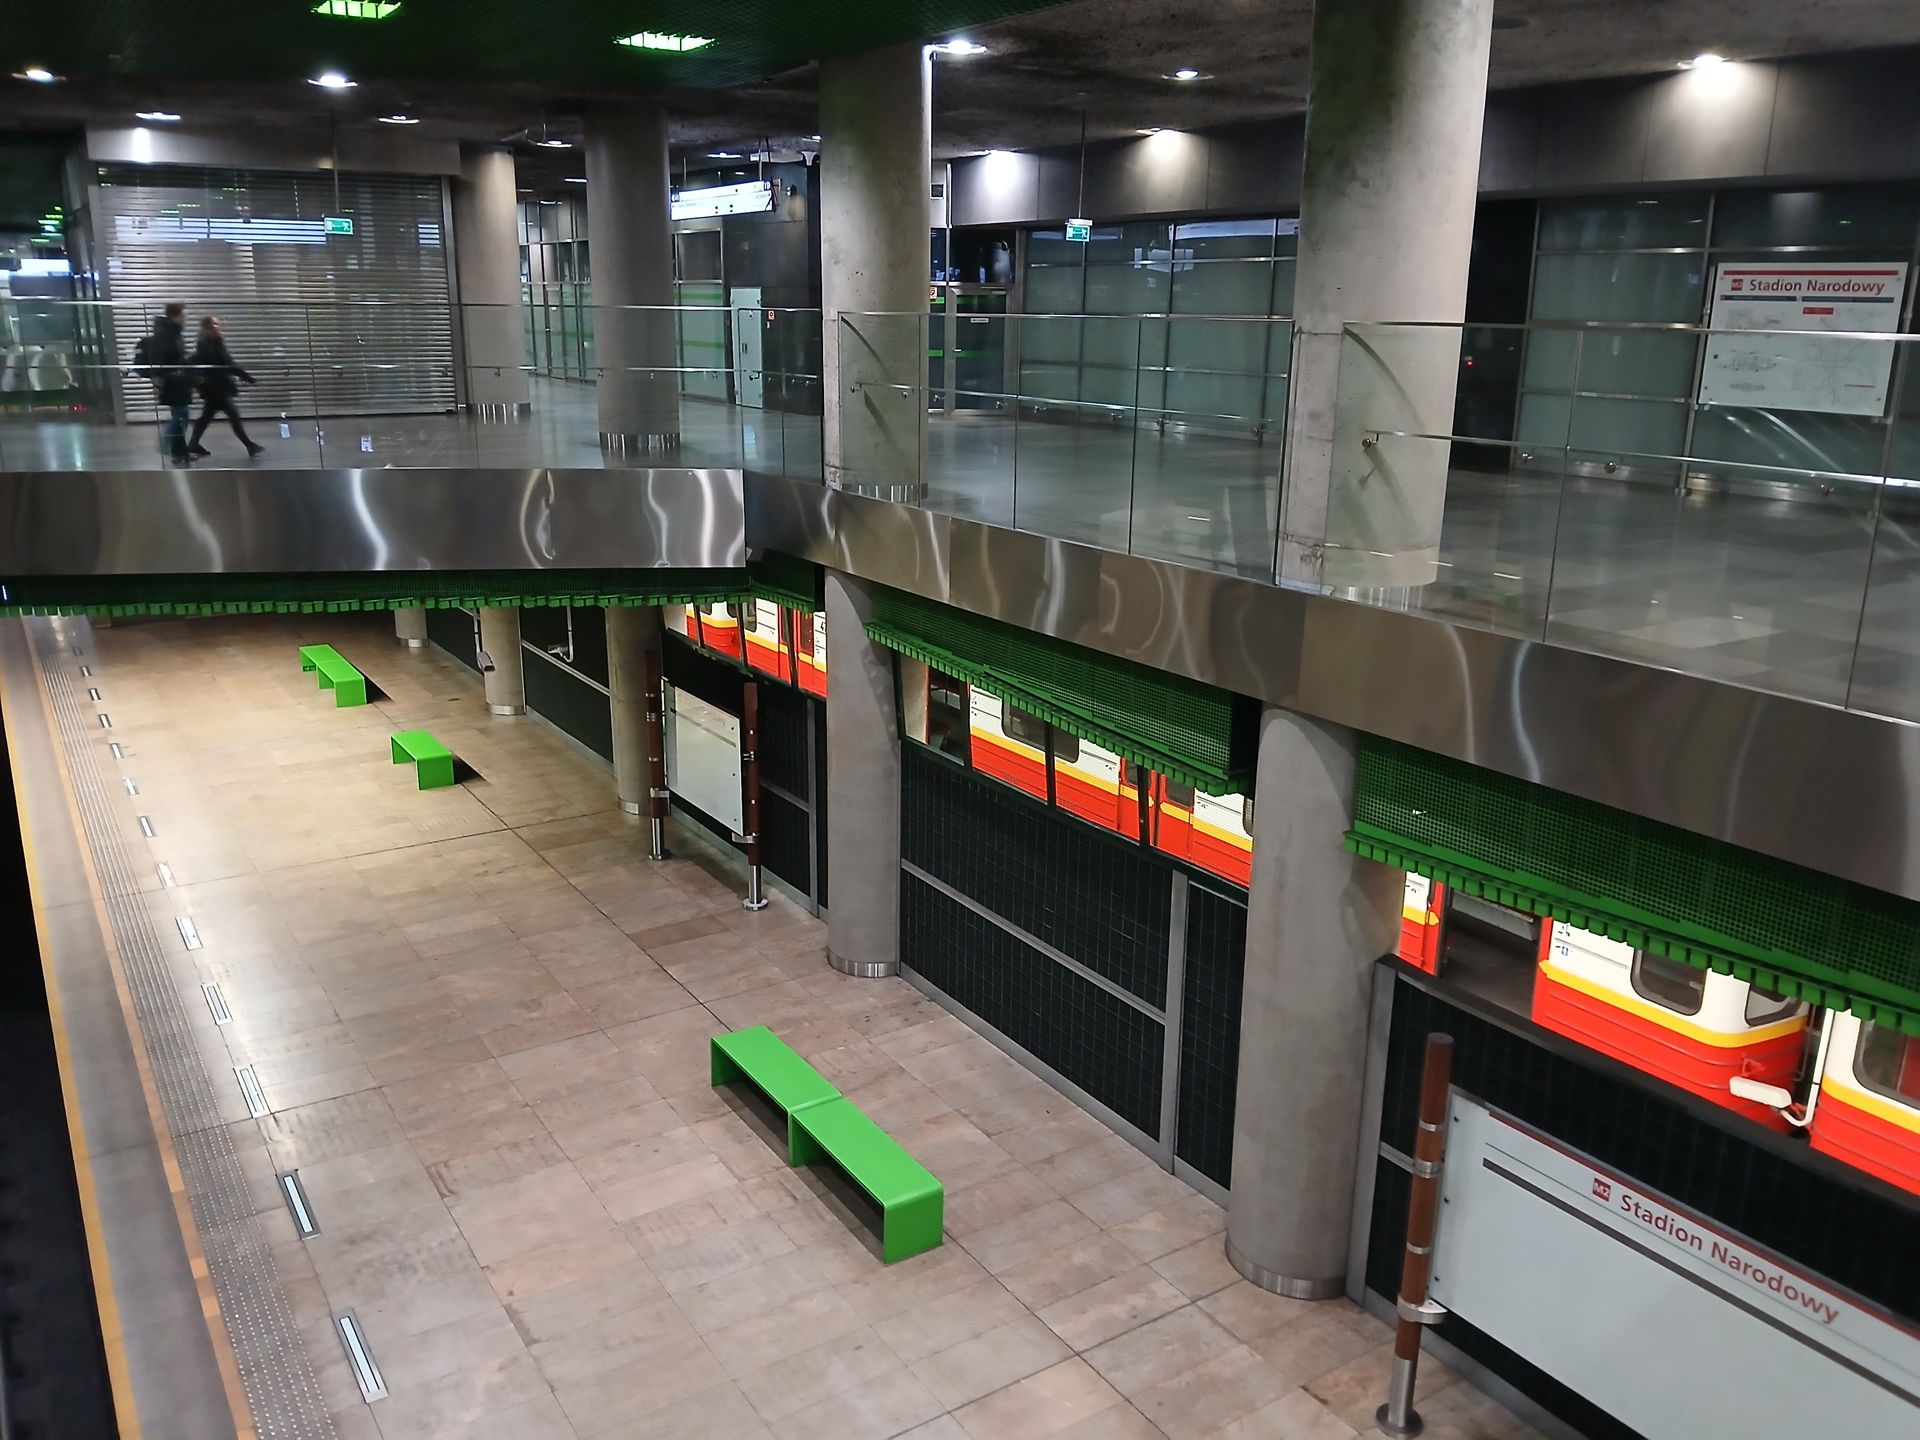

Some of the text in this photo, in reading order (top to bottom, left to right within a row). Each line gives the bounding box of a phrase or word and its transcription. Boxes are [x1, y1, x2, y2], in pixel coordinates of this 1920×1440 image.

[1749, 279, 1802, 292] Stadion
[1806, 280, 1885, 295] Narodowy
[1593, 1181, 1840, 1325] M2 Stadion Narodowy
